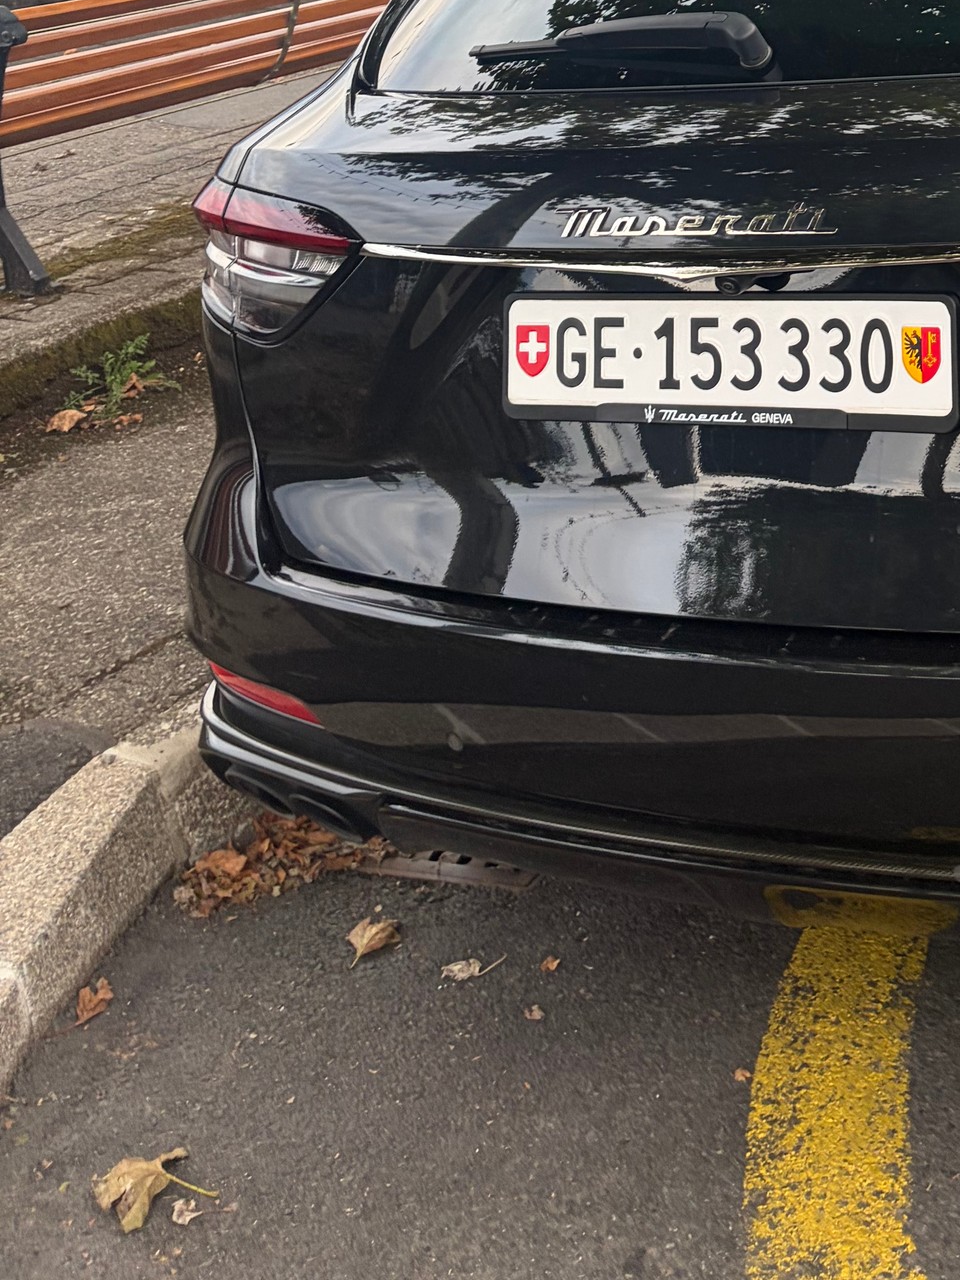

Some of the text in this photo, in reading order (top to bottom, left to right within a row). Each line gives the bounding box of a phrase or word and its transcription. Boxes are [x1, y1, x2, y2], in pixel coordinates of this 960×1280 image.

[555, 202, 839, 238] Maserati
[658, 409, 793, 424] Maserati GENEVA
